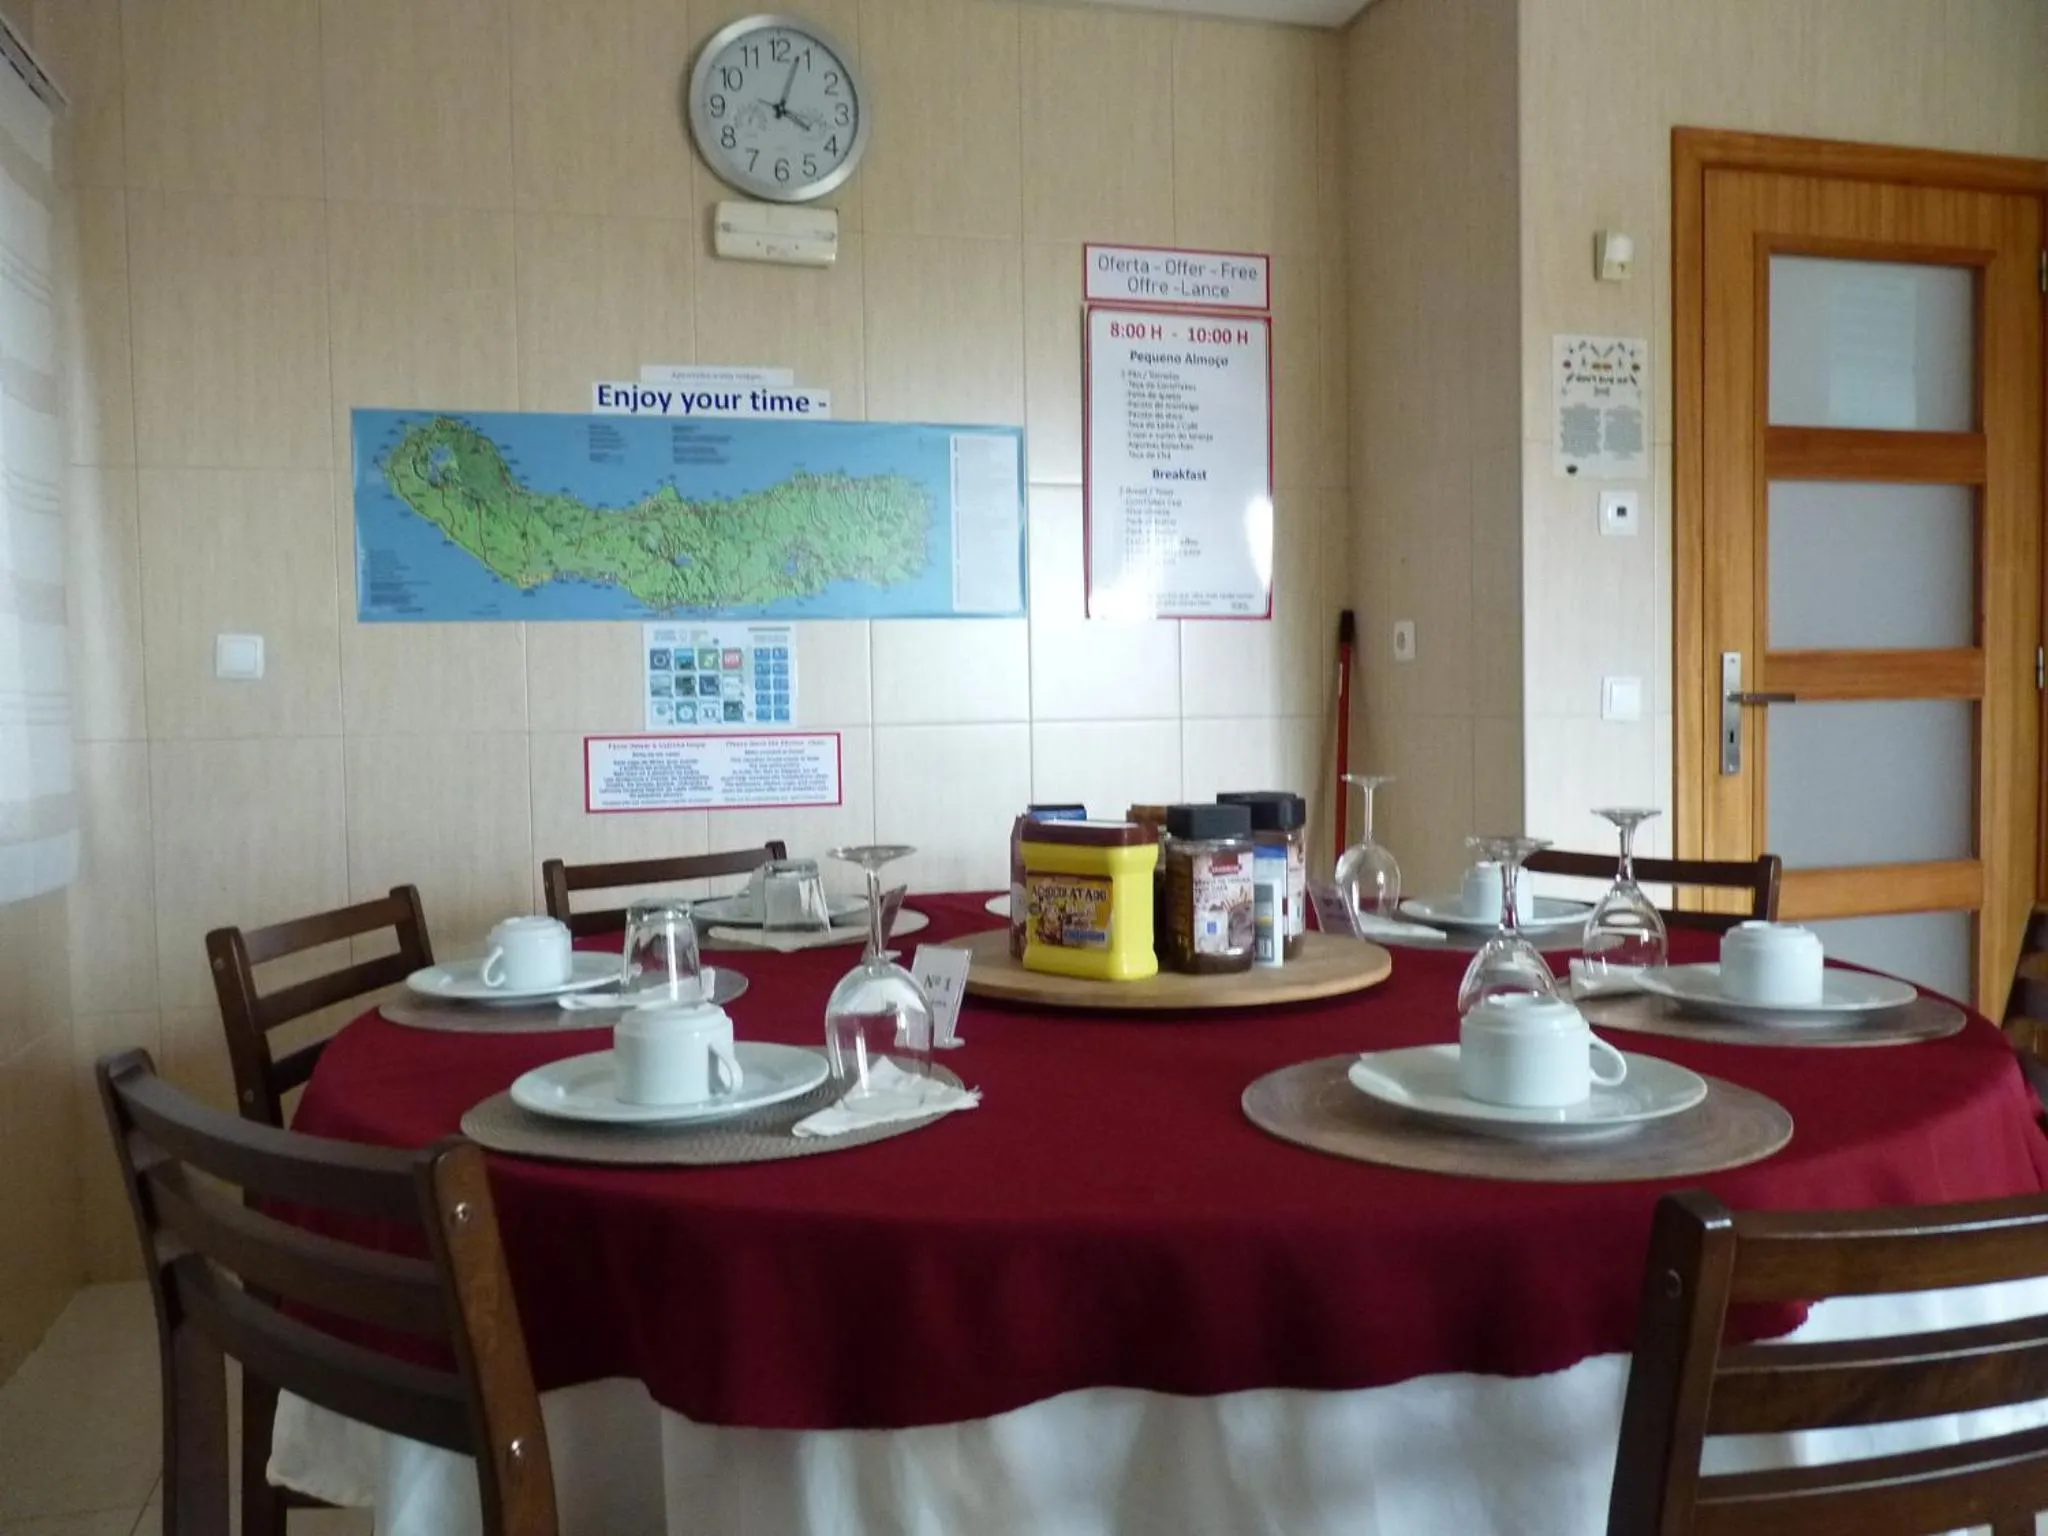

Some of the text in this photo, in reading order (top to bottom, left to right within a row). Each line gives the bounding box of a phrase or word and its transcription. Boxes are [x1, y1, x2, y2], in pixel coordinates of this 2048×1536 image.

[741, 45, 760, 70] 11
[769, 37, 792, 64] 12
[803, 47, 812, 73] 1
[720, 65, 744, 92] 10
[824, 71, 840, 97] 2
[709, 94, 726, 119] 9
[834, 102, 849, 127] 3
[720, 124, 737, 150] 8
[823, 135, 839, 158] 4
[745, 148, 760, 173] 7
[774, 158, 790, 183] 6
[802, 153, 817, 178] 5
[1097, 253, 1150, 275] Oferta
[1165, 258, 1207, 278] Offer
[1220, 261, 1258, 282] Free
[1127, 276, 1169, 296] Offre
[1110, 322, 1146, 339] 8:00
[1150, 325, 1162, 341] H
[1187, 326, 1233, 345] 10:00
[1236, 329, 1249, 346] H
[1129, 351, 1229, 369] Pequeno Almoço
[597, 384, 673, 414] Enjoy
[681, 391, 742, 415] your
[750, 389, 811, 413] time
[1152, 467, 1207, 482] Breakfast
